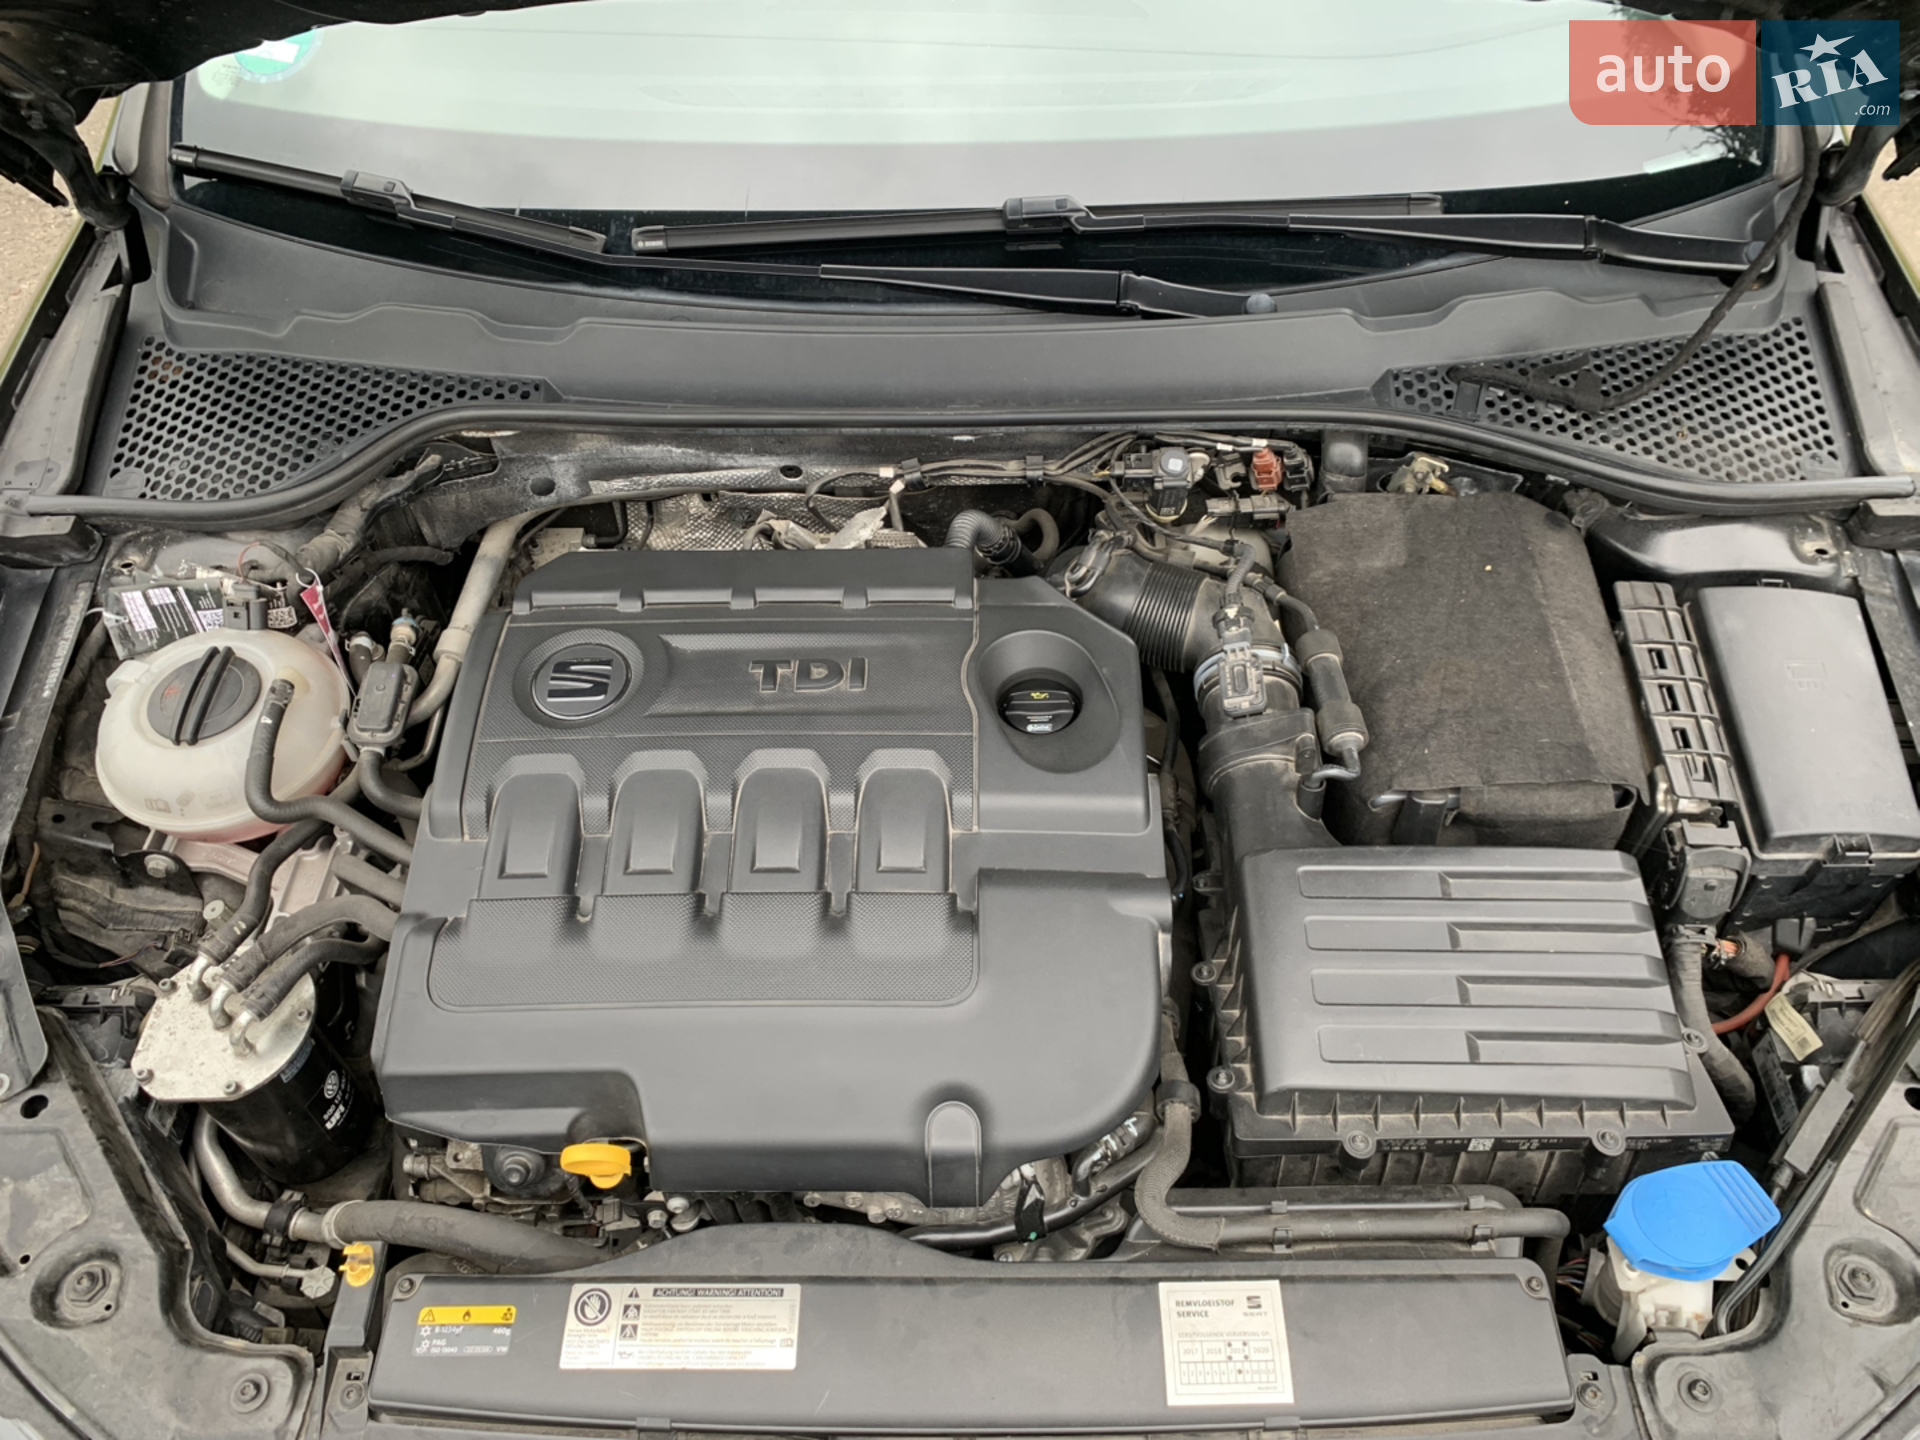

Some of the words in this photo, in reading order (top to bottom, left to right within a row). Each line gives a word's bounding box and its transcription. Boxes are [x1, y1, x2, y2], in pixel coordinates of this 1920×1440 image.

[749, 657, 868, 693] TDI
[655, 1289, 695, 1297] ACHTUNG!
[697, 1289, 736, 1297] WARNING!
[738, 1288, 782, 1297] ATTENTION!
[1175, 1300, 1235, 1308] REMVLOEISTOF
[1176, 1310, 1209, 1318] SERVICE
